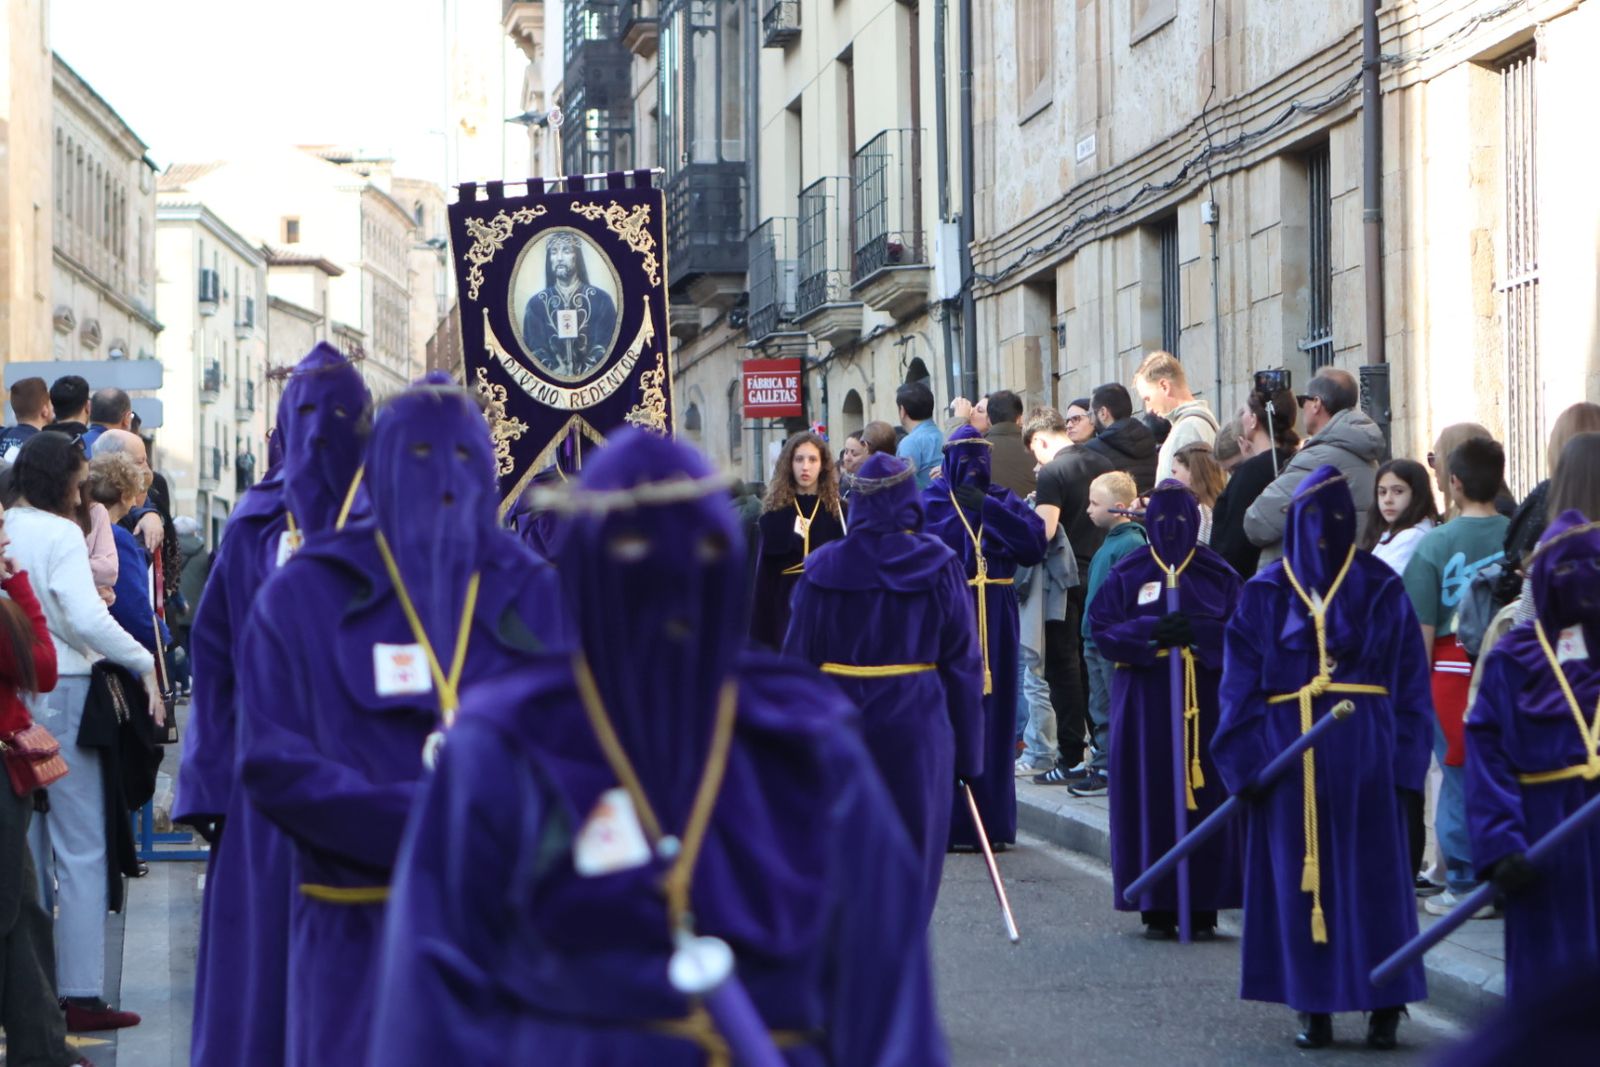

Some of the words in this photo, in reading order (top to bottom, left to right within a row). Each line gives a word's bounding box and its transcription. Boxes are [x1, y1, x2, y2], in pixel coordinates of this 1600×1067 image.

[503, 357, 559, 405] DIVINO
[570, 350, 640, 408] REDENTOR
[747, 375, 783, 390] FÁBRICA
[785, 376, 798, 389] DE
[748, 389, 797, 404] GALLETAS
